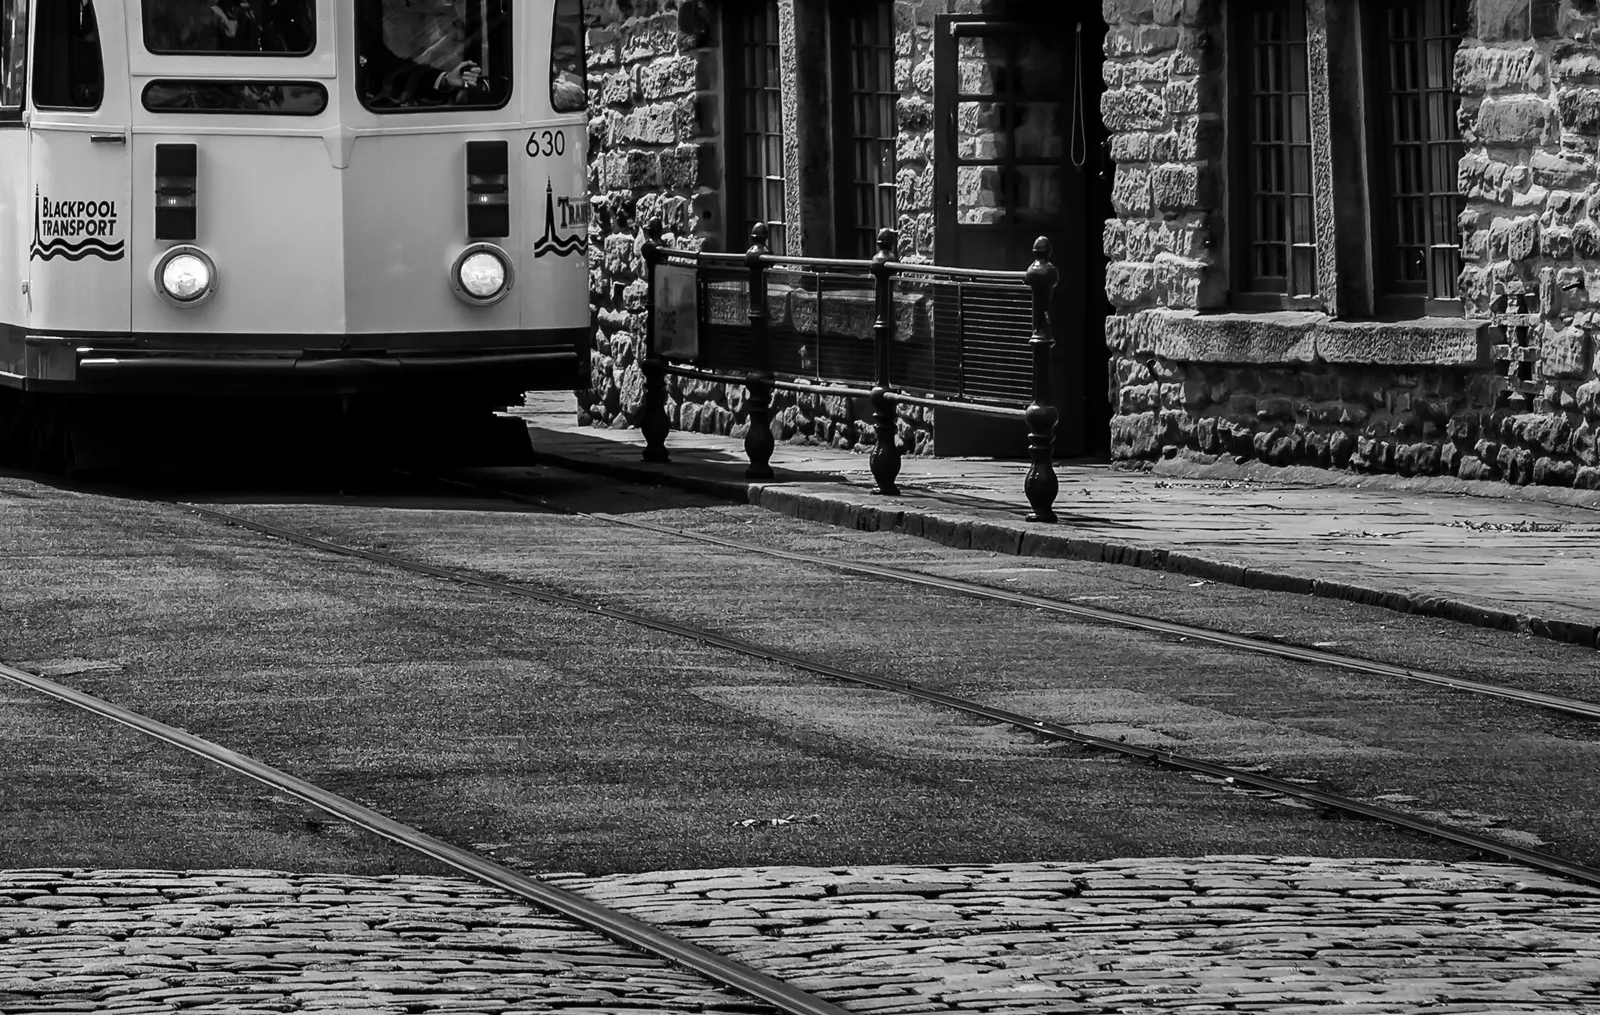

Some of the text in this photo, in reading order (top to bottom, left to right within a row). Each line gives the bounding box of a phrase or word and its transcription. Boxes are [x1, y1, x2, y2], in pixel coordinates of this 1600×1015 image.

[525, 129, 566, 158] 630
[42, 196, 118, 218] BLACKPOOL
[42, 219, 117, 237] TRANSPORT
